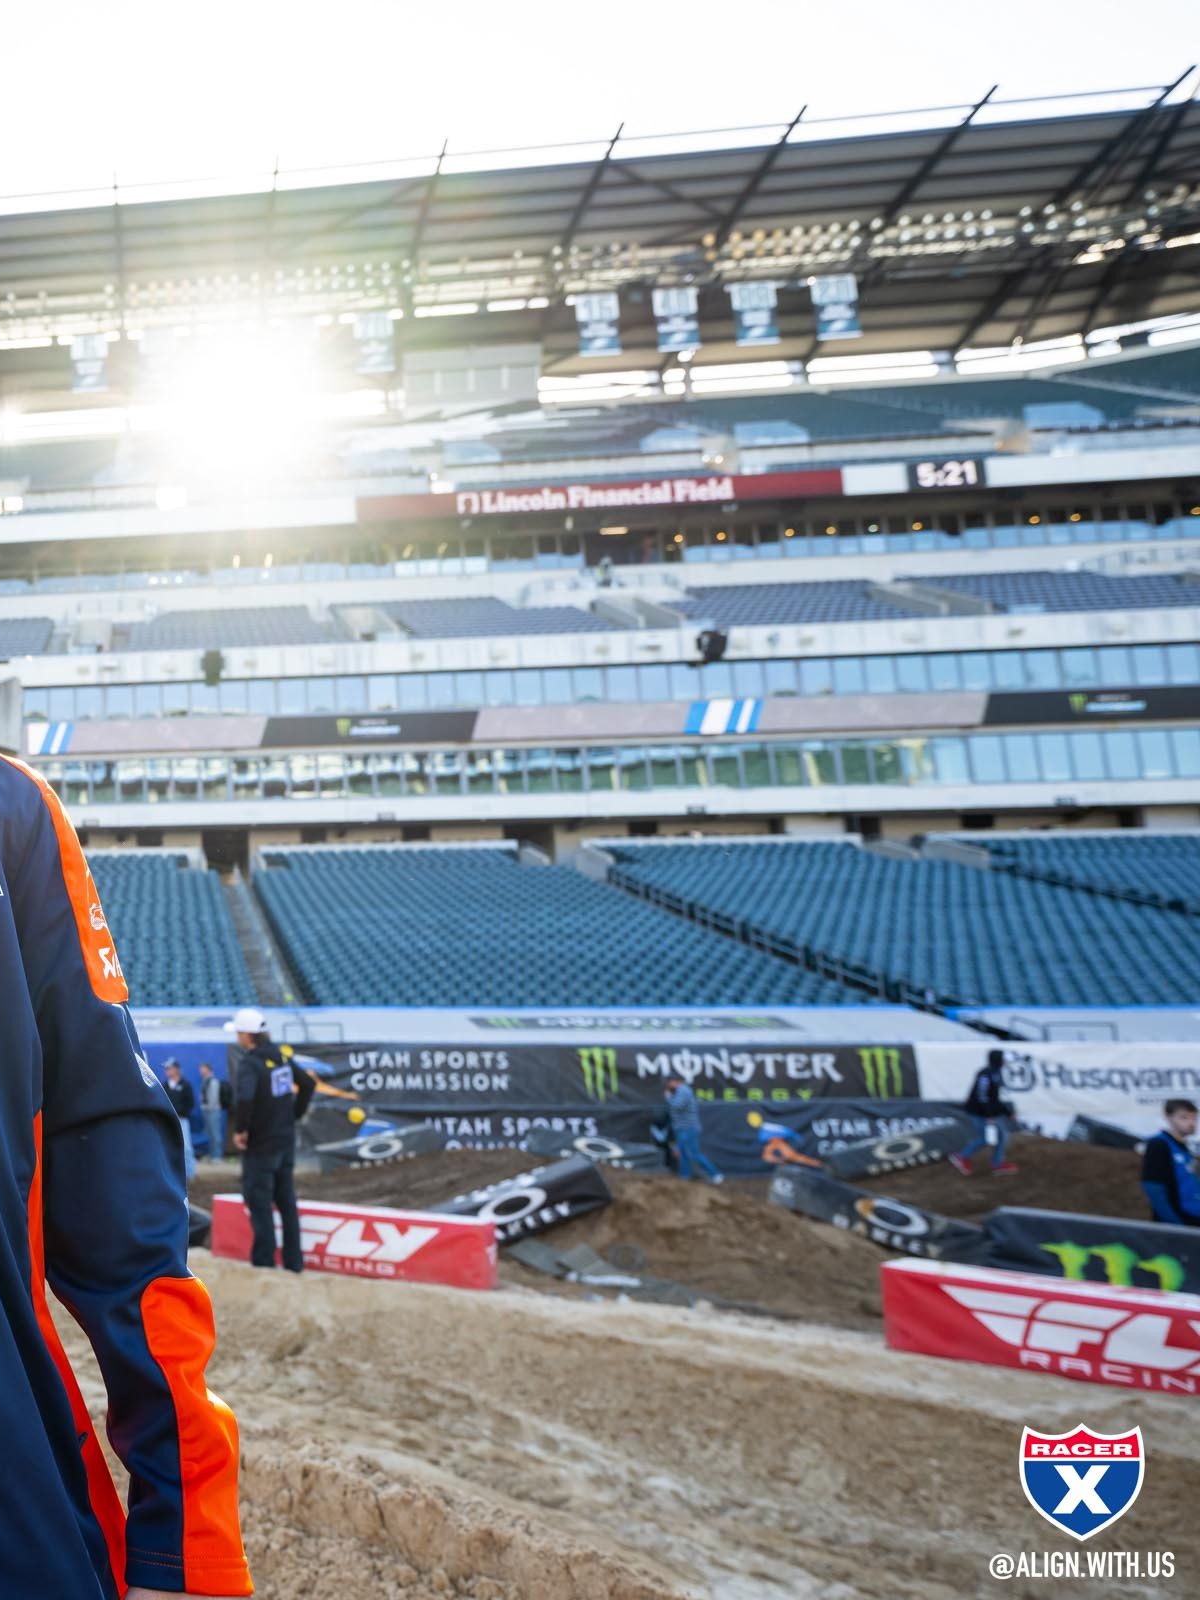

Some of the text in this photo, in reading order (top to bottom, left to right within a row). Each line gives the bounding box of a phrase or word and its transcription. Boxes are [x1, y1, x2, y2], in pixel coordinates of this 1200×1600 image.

[916, 460, 978, 487] 5:21
[482, 477, 734, 514] Lincoln Financial Field
[349, 1050, 509, 1070] UTAH SPORTS
[636, 1048, 843, 1084] MONSTER
[351, 1073, 510, 1092] COMMISSION
[1042, 1062, 1200, 1092] Husqvarn
[696, 1087, 814, 1101] NERGY
[812, 1118, 871, 1138] UTAH
